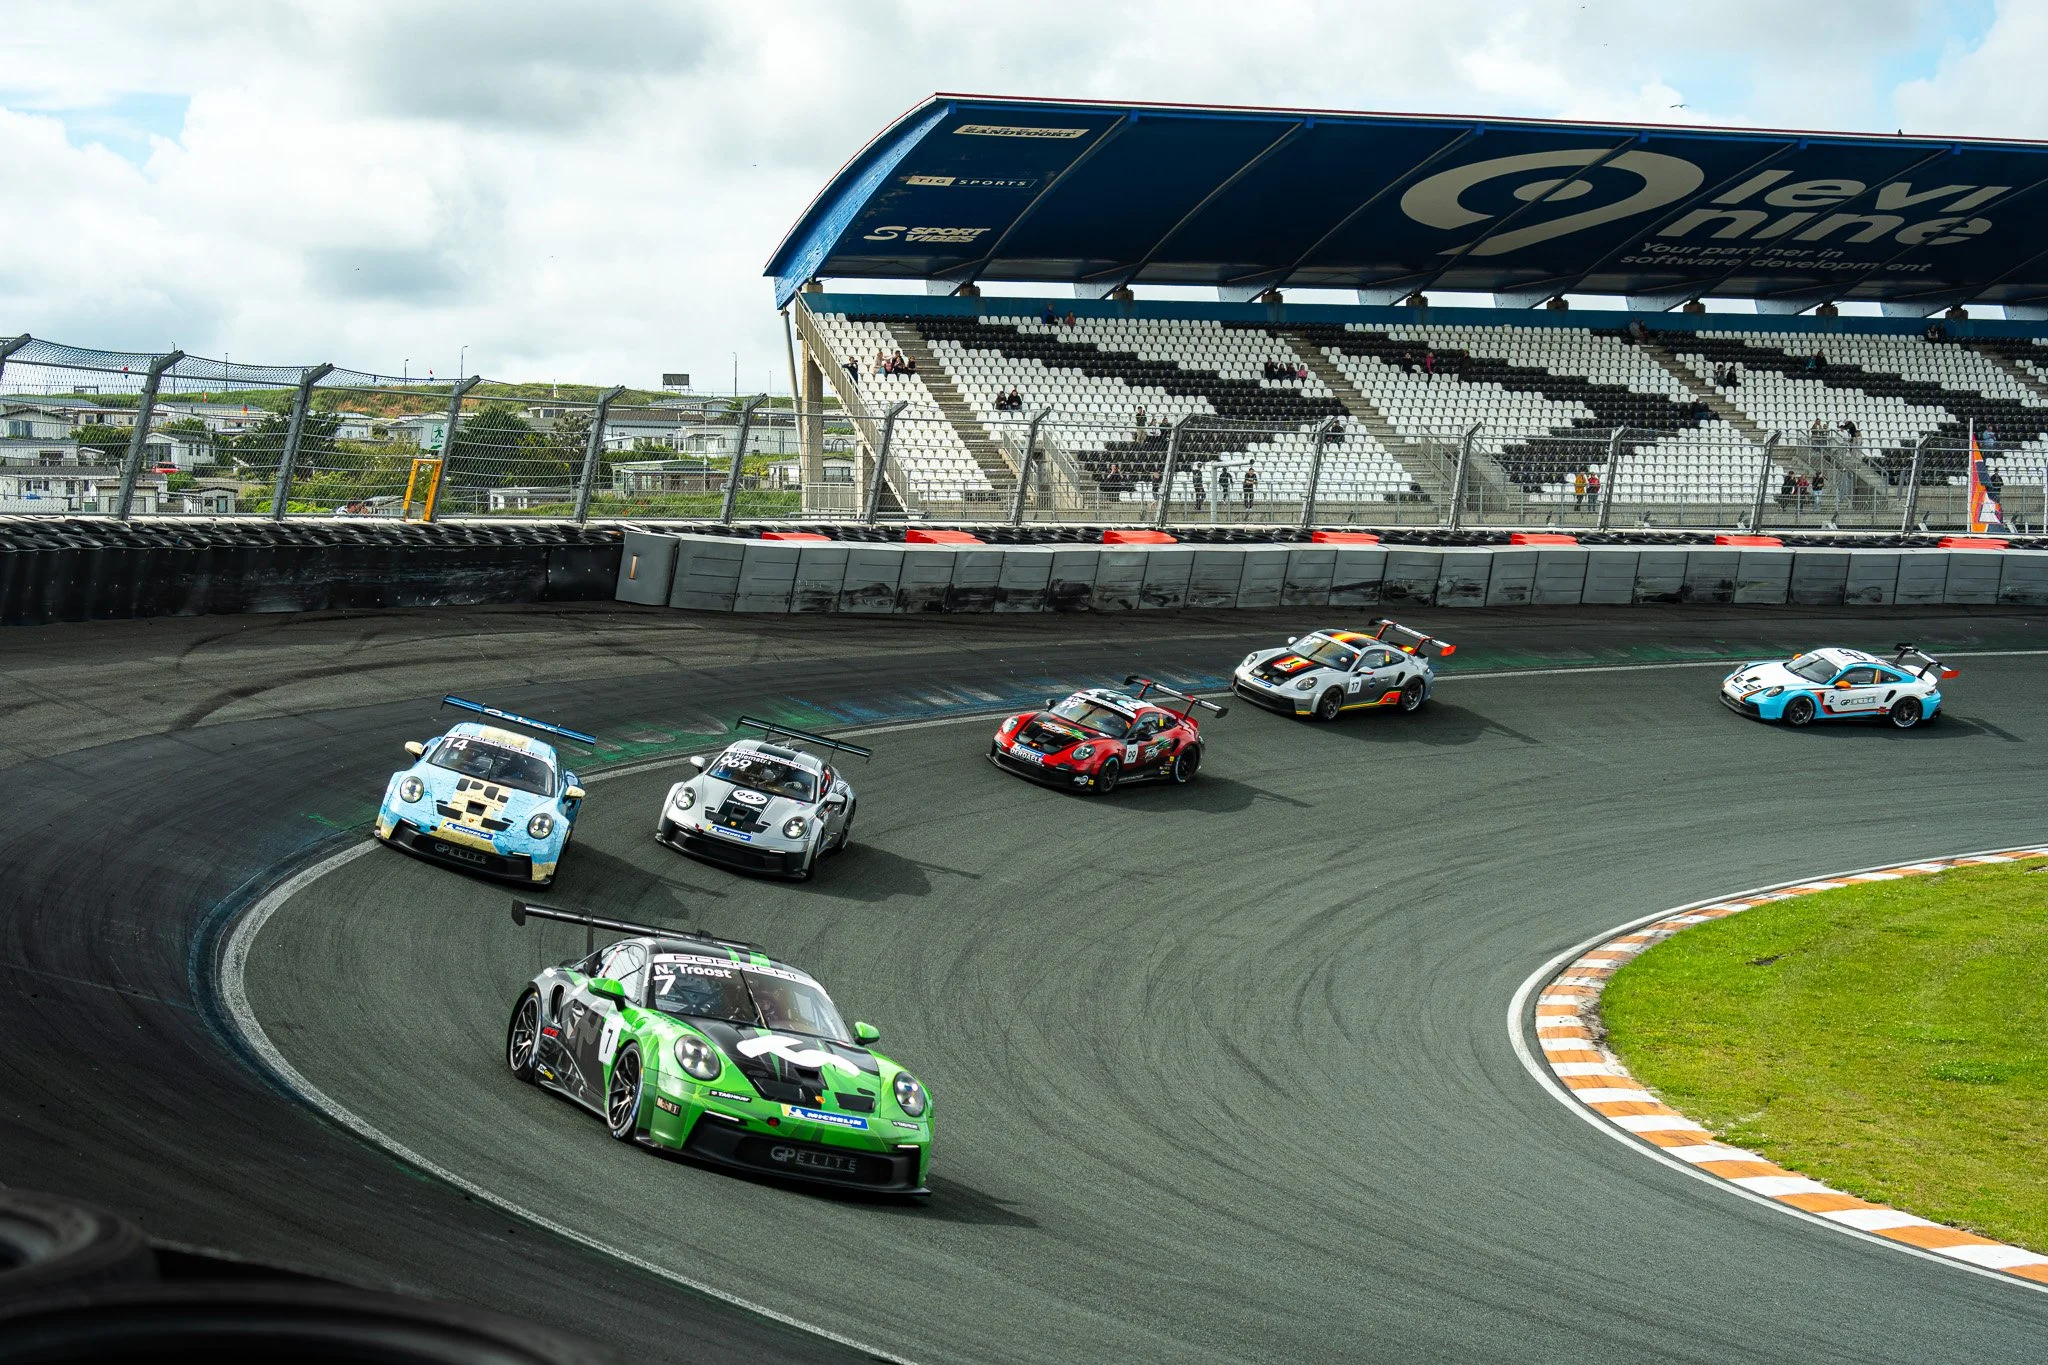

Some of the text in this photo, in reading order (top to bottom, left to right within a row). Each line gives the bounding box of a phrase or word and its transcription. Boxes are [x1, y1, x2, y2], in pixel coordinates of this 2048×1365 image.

[958, 179, 1027, 187] SPORTS
[1711, 169, 2013, 213] levi
[906, 227, 991, 236] SPORT
[1656, 208, 1993, 246] nine
[905, 235, 979, 243] VIBES
[1641, 242, 1701, 256] Your
[1818, 247, 1844, 259] in
[1620, 253, 1743, 268] software
[1351, 681, 1359, 691] 17
[1829, 695, 1835, 703] 2
[444, 737, 469, 751] 14
[720, 755, 752, 769] 969
[1127, 750, 1137, 761] 99
[737, 791, 764, 802] 969
[654, 963, 732, 979] N. Troost
[653, 974, 677, 995] 7
[604, 1028, 613, 1054] 7
[806, 1111, 862, 1127] MICHELIN
